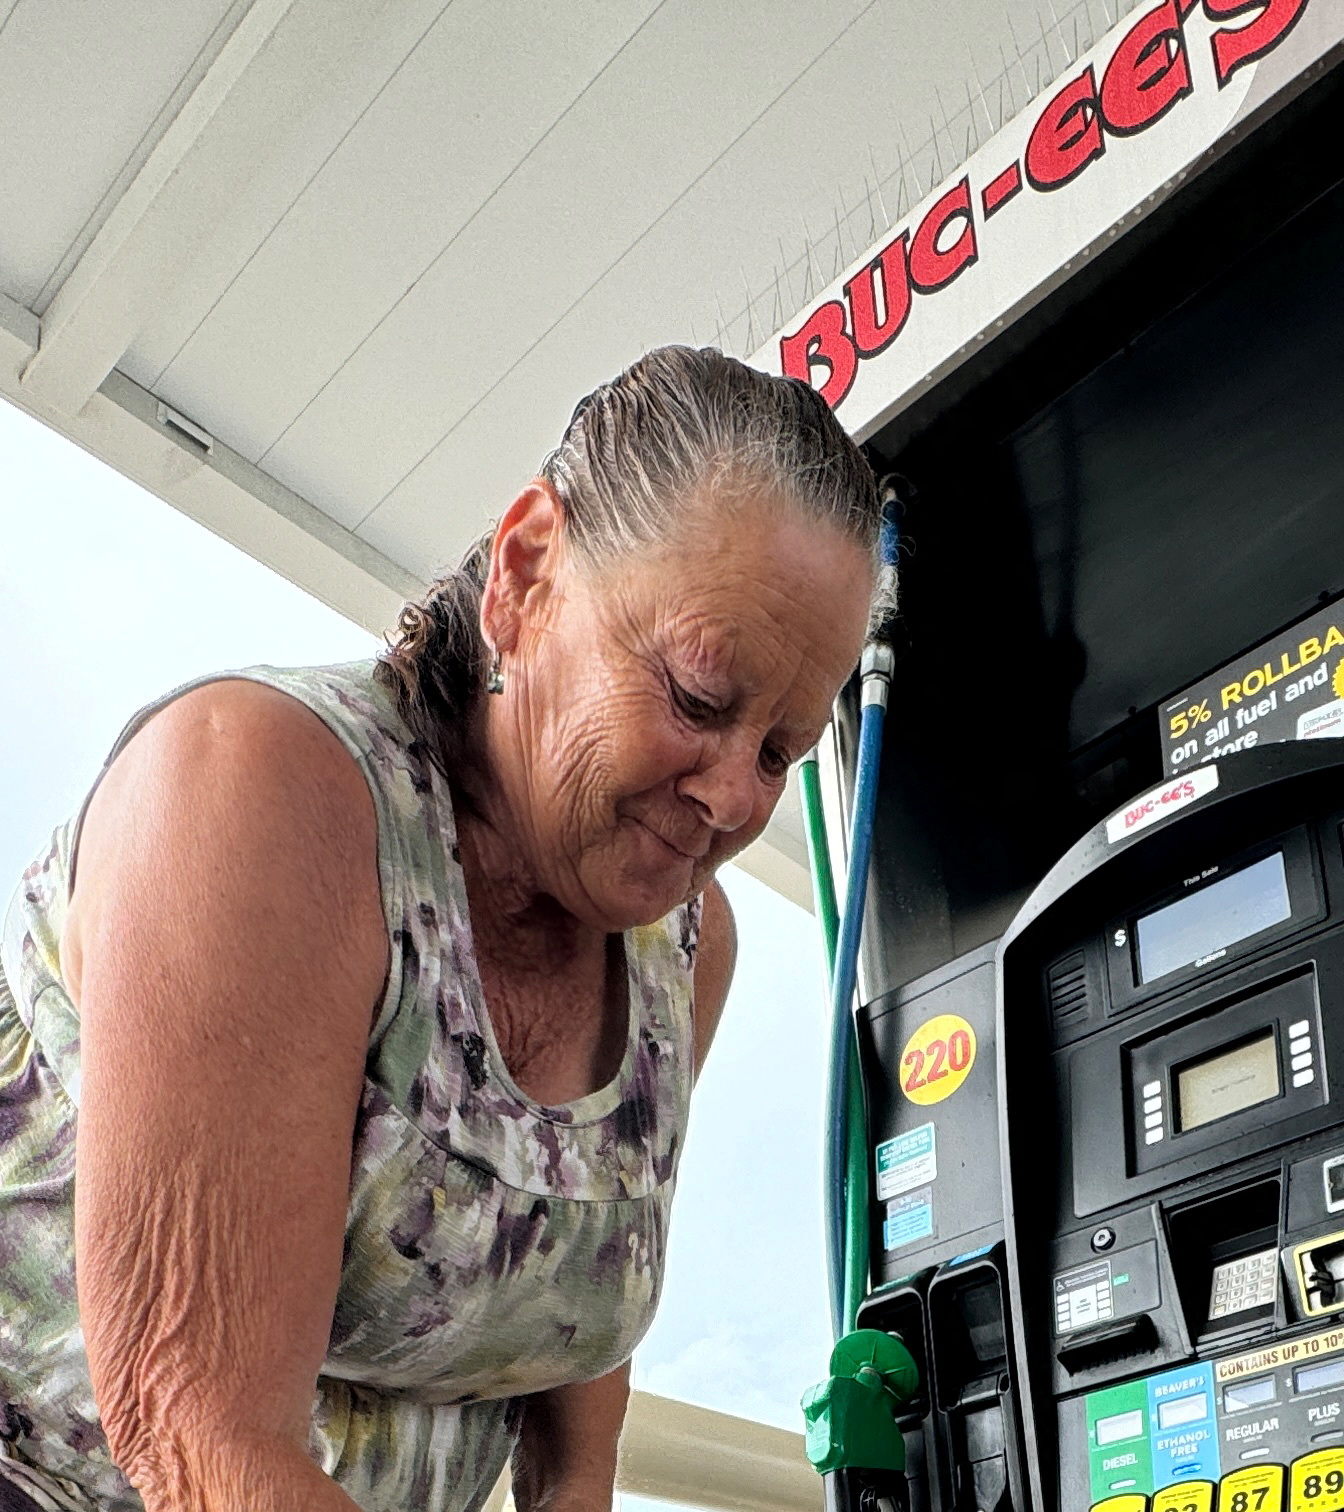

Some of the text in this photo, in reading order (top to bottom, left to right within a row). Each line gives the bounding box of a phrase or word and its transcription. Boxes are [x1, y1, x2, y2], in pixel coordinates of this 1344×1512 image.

[780, 0, 1310, 410] BUC-EES
[1169, 699, 1212, 739] 5%
[1171, 738, 1198, 764] on
[1205, 719, 1229, 745] all
[1235, 691, 1278, 730] fuel
[1284, 662, 1328, 703] and
[1201, 731, 1258, 764] tore
[1114, 929, 1126, 947] $
[905, 1029, 971, 1092] 220
[1220, 1350, 1278, 1378] CONTAINS
[1282, 1345, 1298, 1364] UP
[1303, 1339, 1320, 1357] TO
[1155, 1376, 1205, 1397] BEAVER'S
[1308, 1403, 1340, 1421] PLUS
[1157, 1429, 1211, 1450] ETHANOL
[1226, 1418, 1279, 1442] REGULAR
[1103, 1453, 1138, 1471] DIESEL
[1171, 1444, 1198, 1459] FREE
[1304, 1471, 1344, 1499] 89
